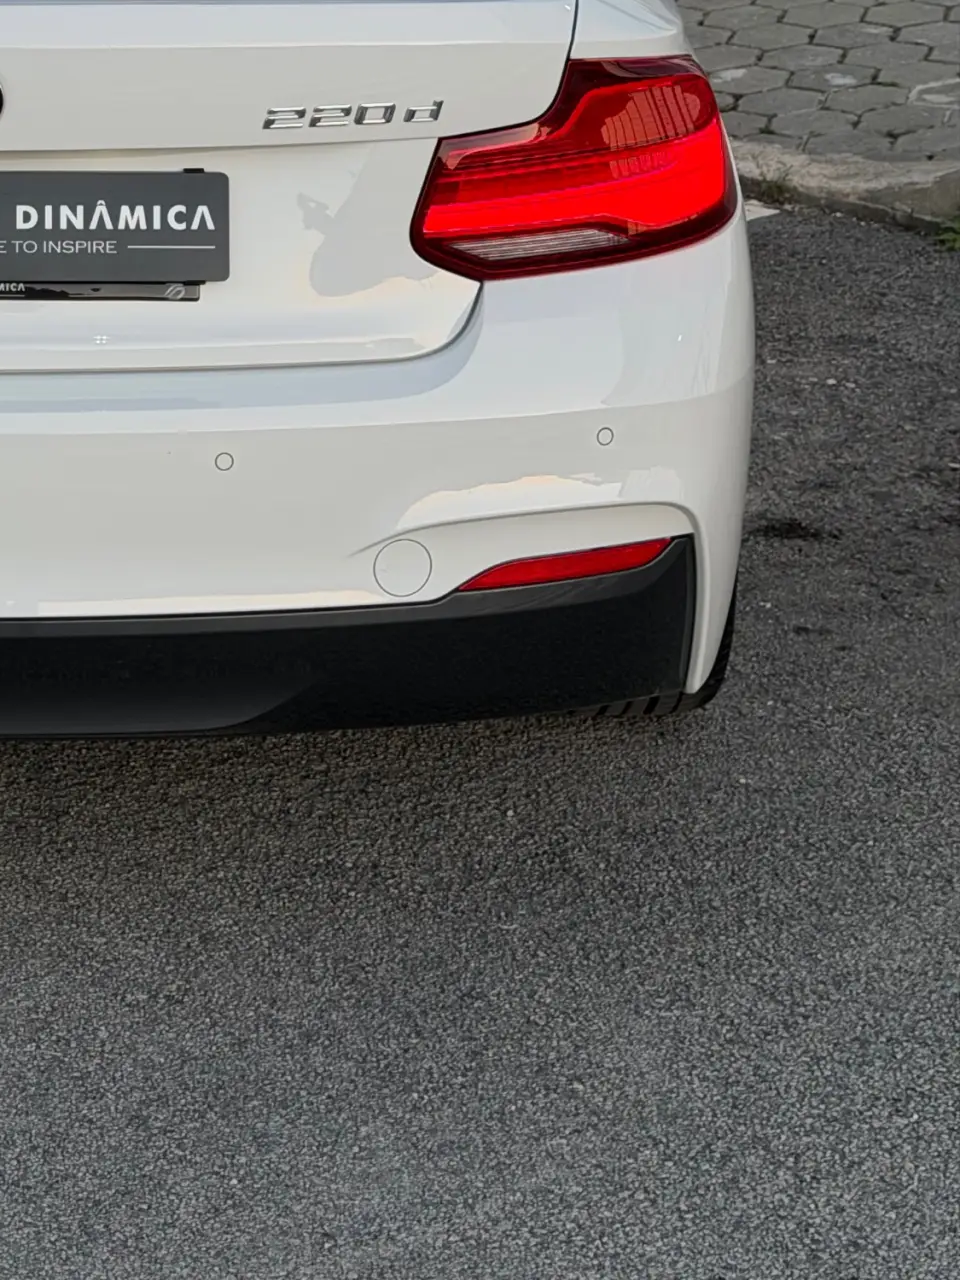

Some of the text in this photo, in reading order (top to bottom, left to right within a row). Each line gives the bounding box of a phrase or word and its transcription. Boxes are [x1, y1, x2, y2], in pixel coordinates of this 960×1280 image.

[262, 100, 444, 130] 220d
[15, 199, 216, 231] DINÂMICA
[11, 240, 38, 254] TO
[43, 240, 117, 254] INSPIRE
